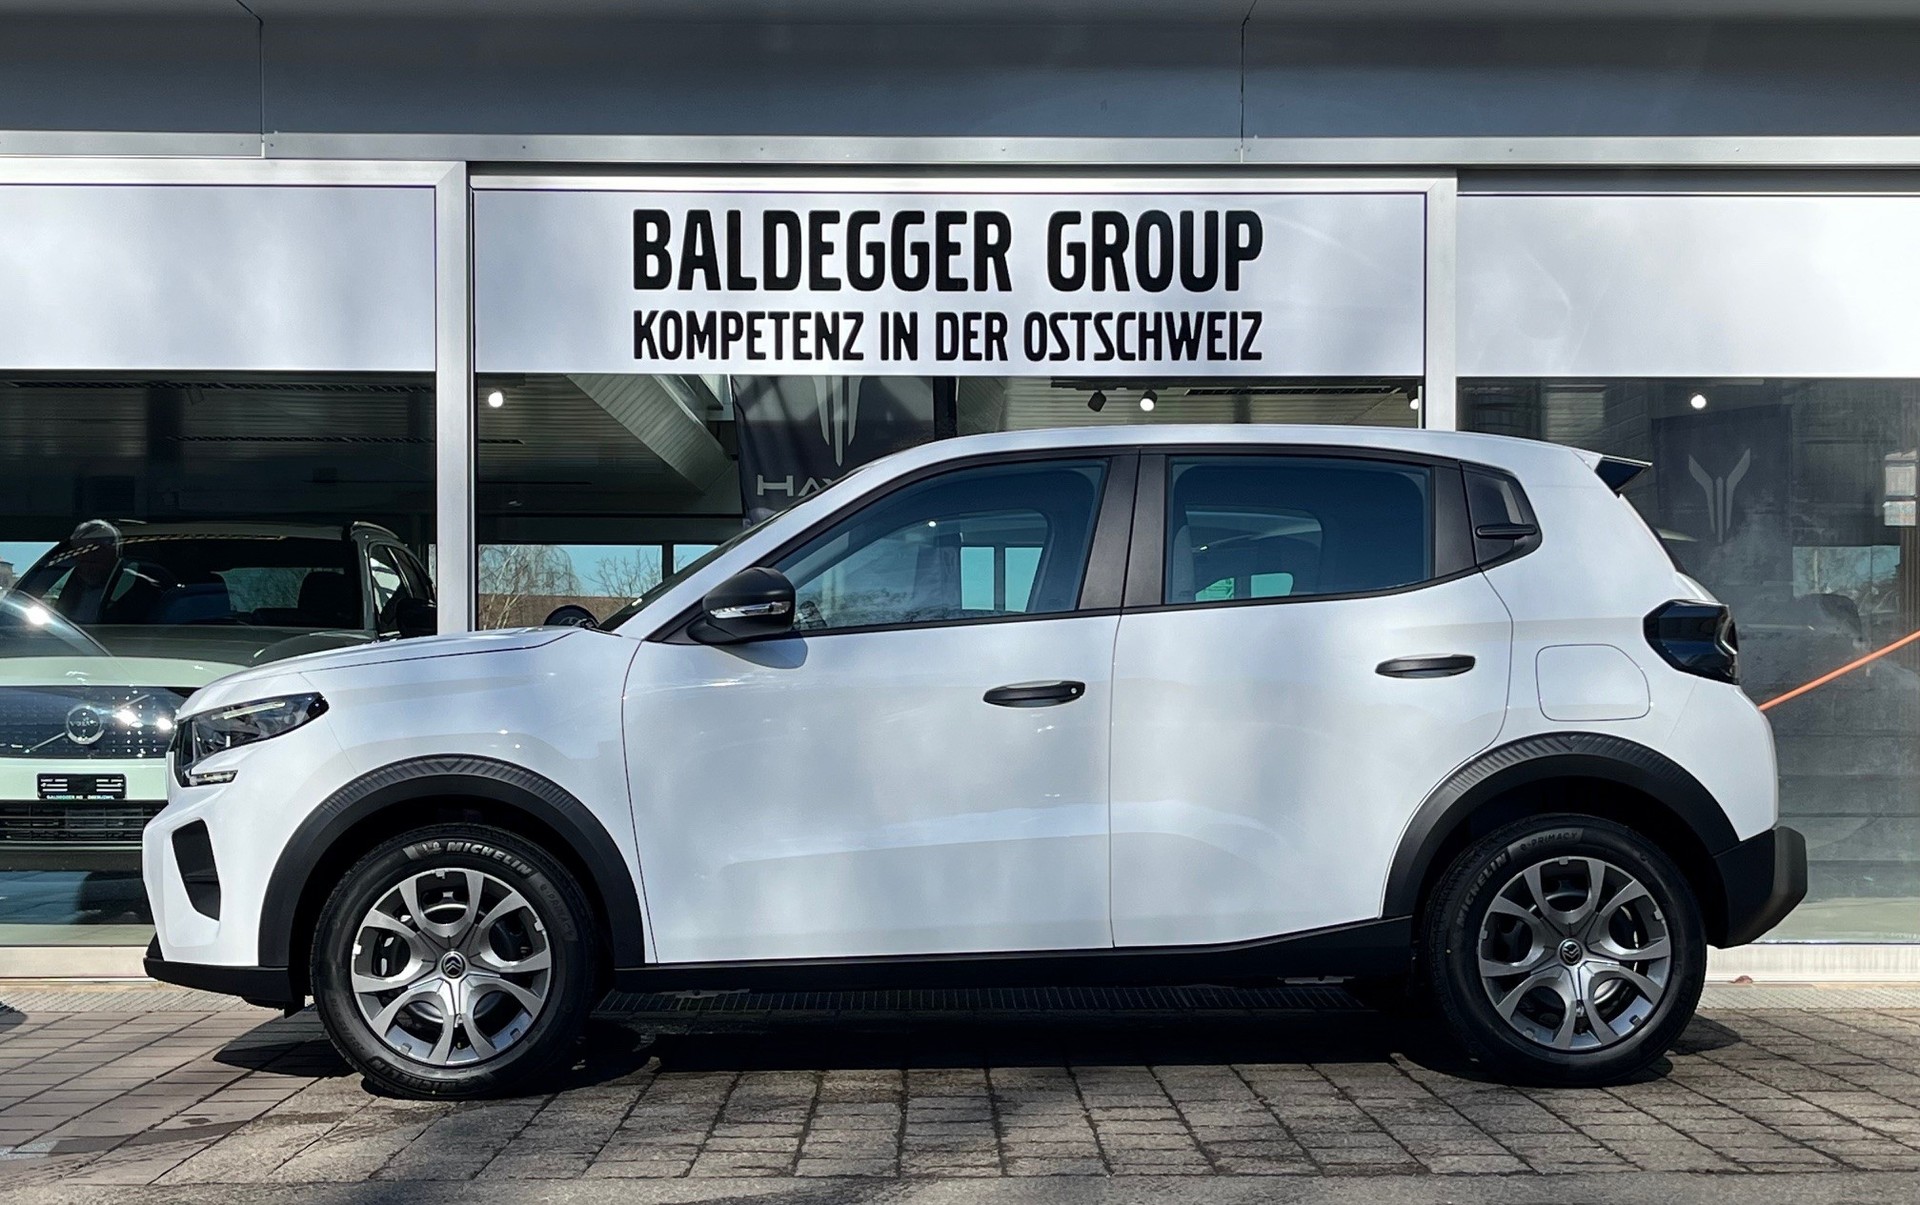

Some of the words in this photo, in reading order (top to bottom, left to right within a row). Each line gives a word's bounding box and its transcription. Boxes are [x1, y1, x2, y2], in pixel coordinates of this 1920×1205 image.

[633, 209, 1013, 292] BALDEGGER
[1047, 209, 1263, 293] GROUP
[633, 310, 864, 361] KOMPETENZ
[880, 311, 918, 361] IN
[935, 311, 1009, 362] DER
[1023, 311, 1263, 362] OSTSCHWEIZ
[446, 841, 532, 876] MICHELIN
[1456, 851, 1508, 926] MICHELIN
